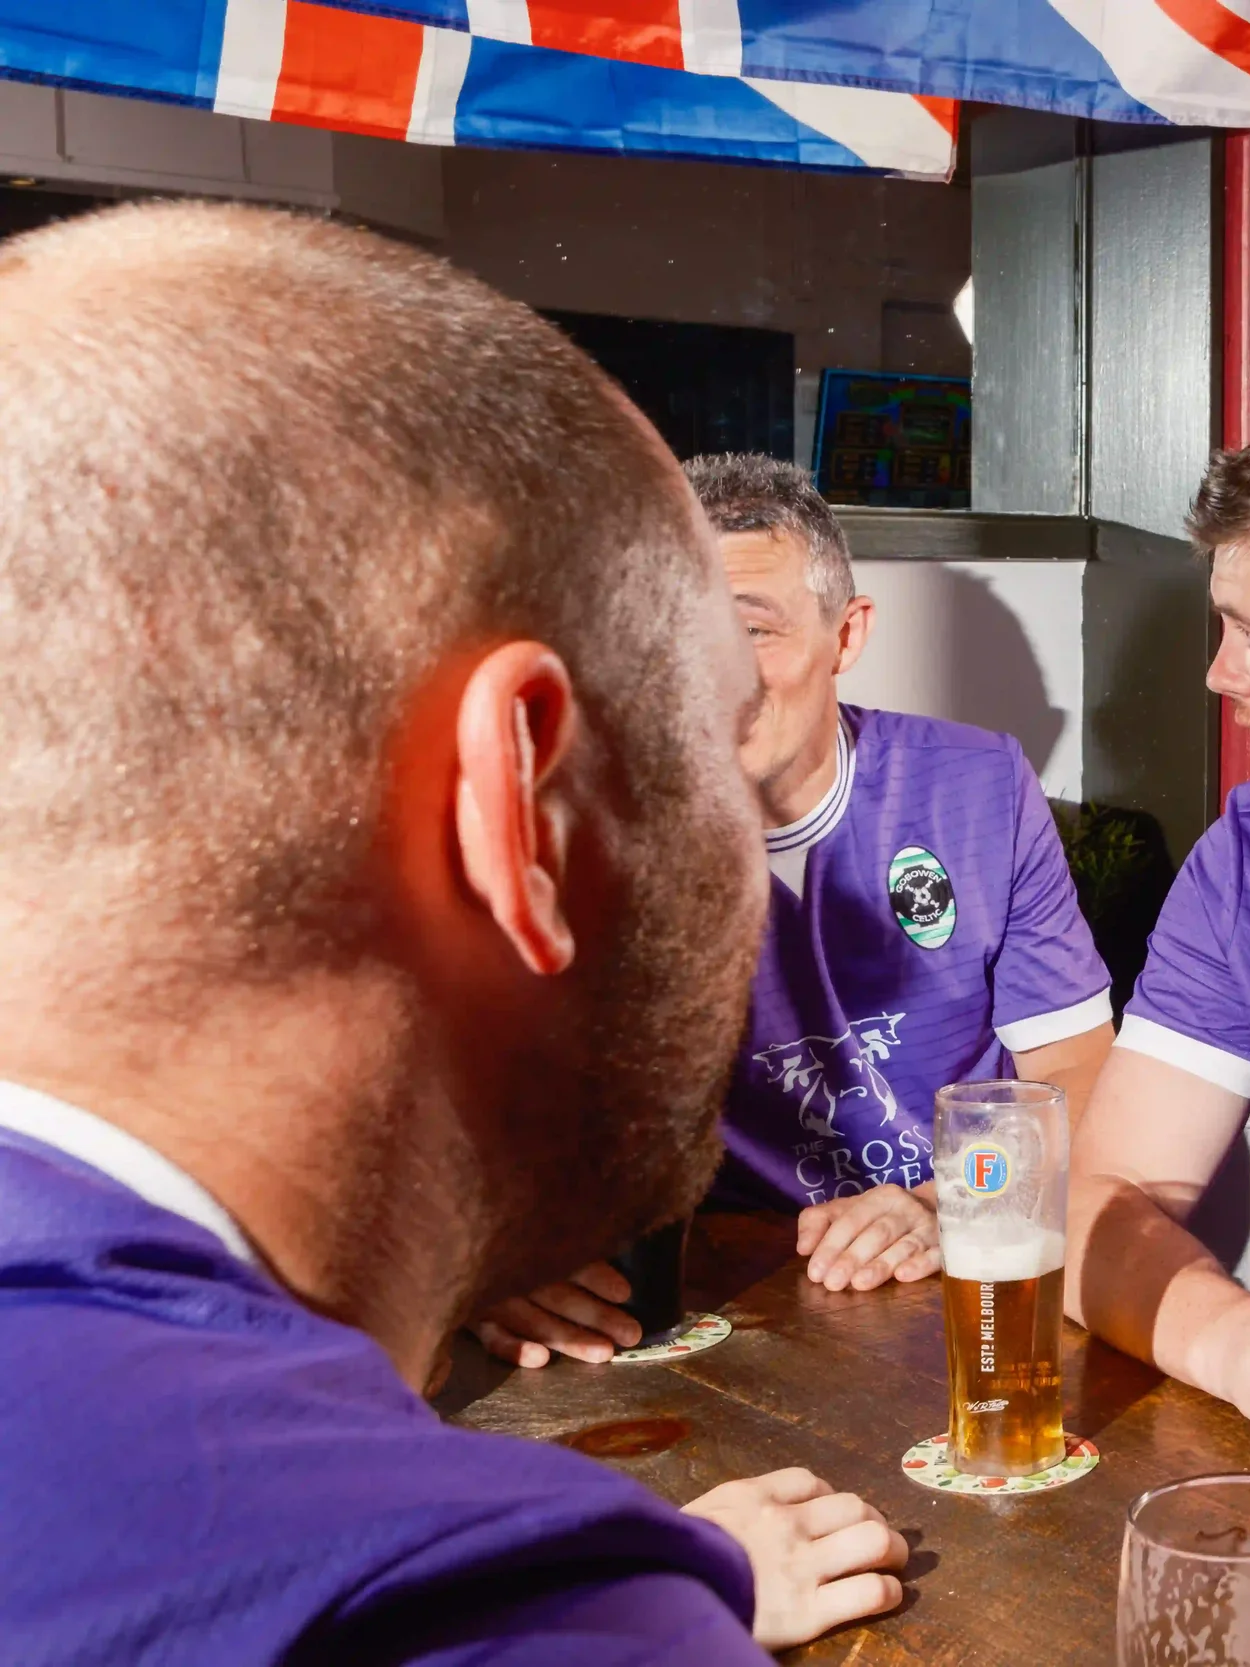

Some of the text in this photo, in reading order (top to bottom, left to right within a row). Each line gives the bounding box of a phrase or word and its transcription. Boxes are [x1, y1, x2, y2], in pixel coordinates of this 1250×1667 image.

[896, 869, 942, 893] GOBOWEN
[912, 908, 943, 923] CELTIC
[792, 1140, 824, 1155] THE
[796, 1125, 934, 1188] CROSS
[974, 1152, 997, 1189] F
